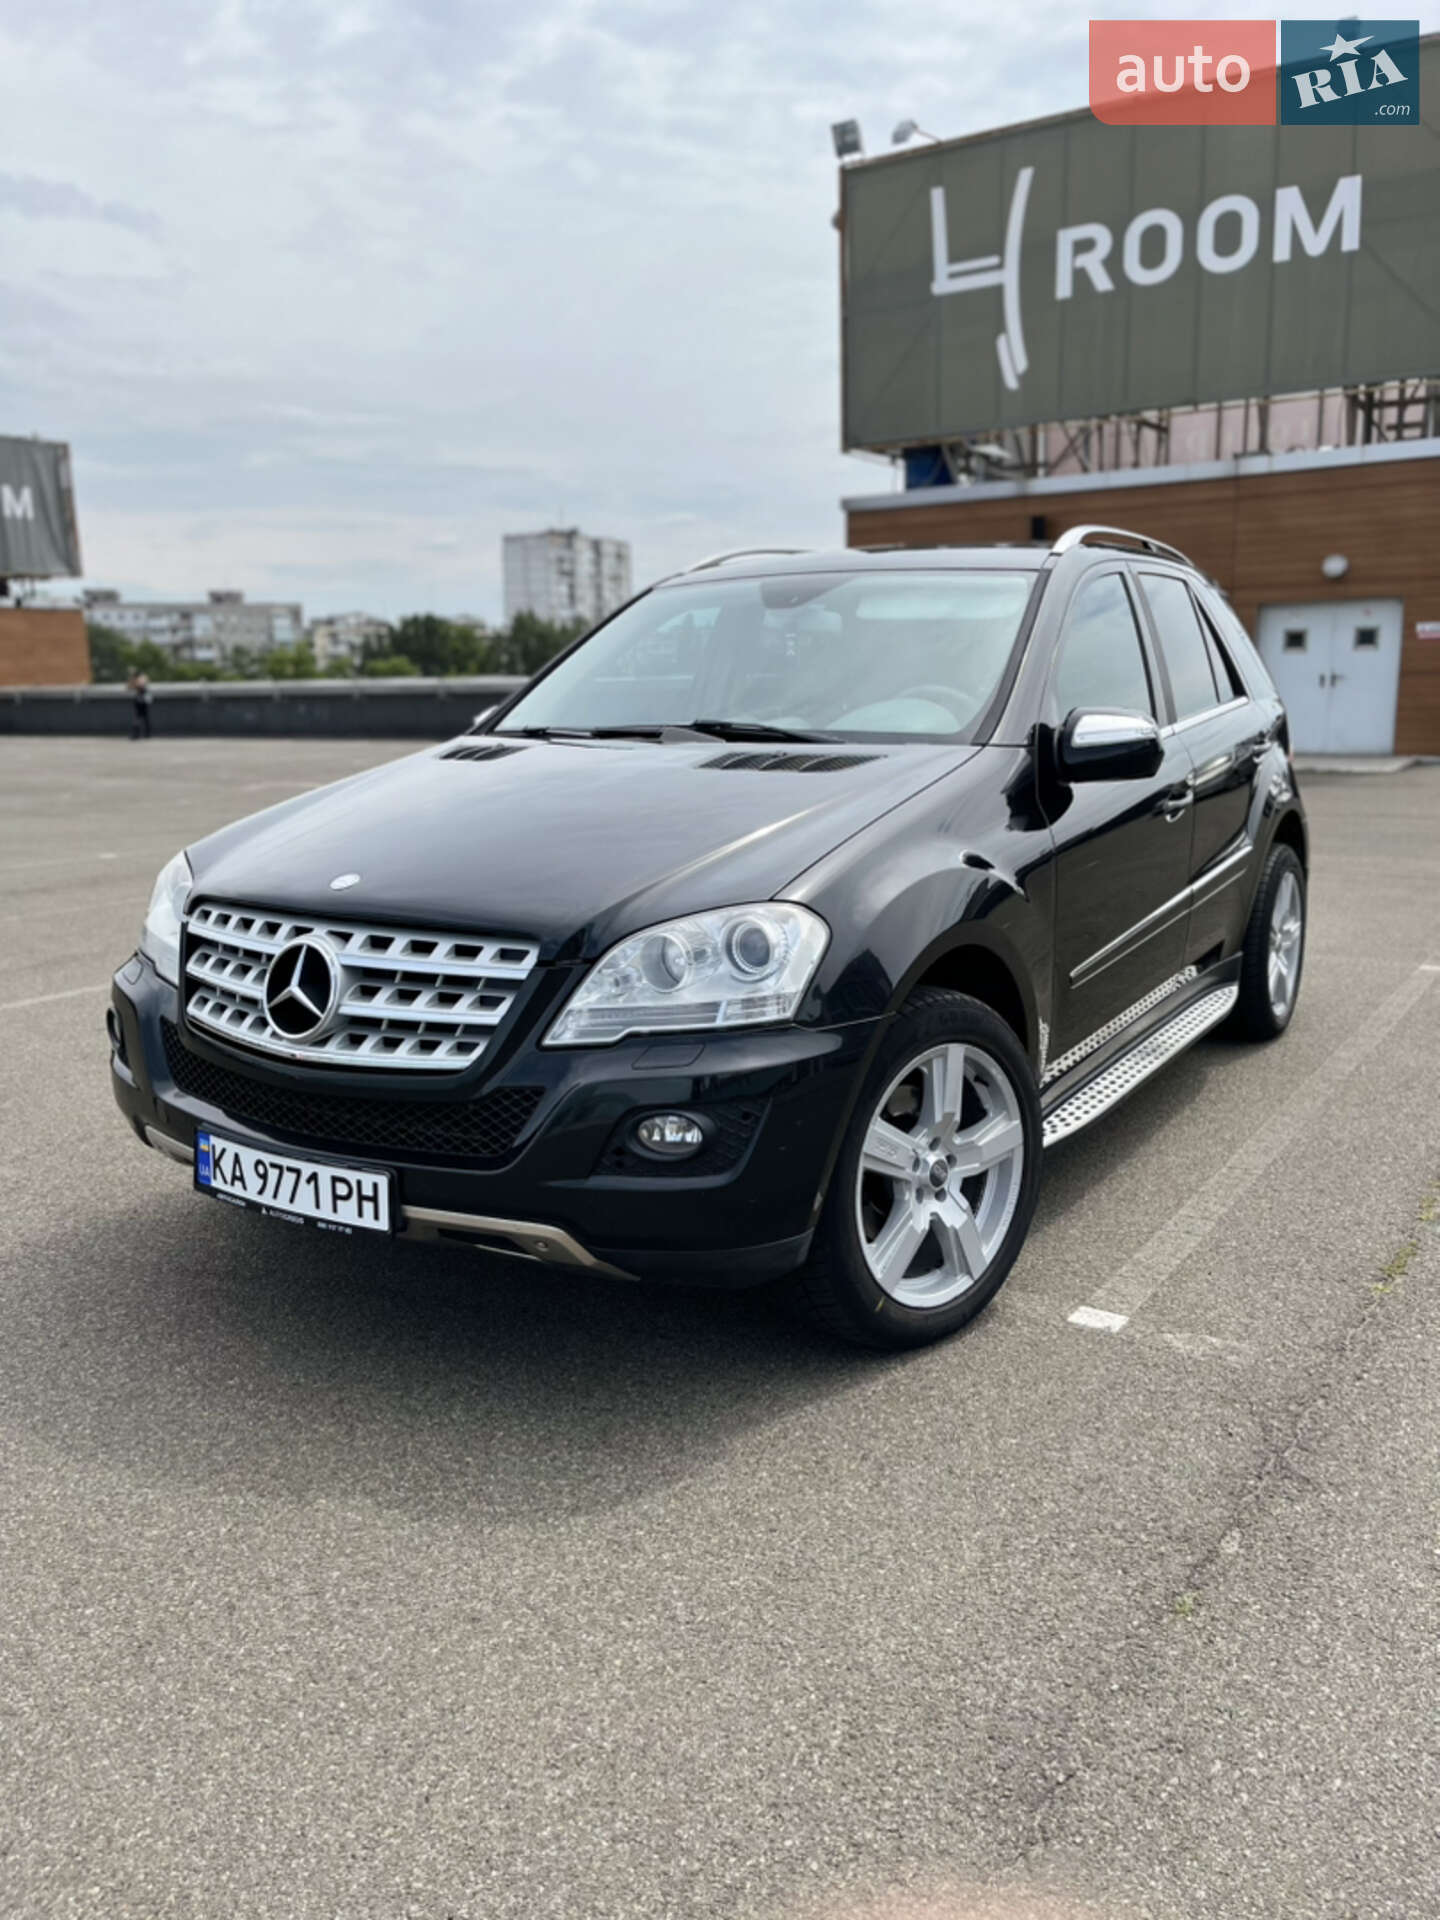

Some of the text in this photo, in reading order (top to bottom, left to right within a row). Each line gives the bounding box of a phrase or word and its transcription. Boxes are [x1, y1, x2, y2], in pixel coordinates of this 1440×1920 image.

[1055, 174, 1362, 300] ROOM
[212, 1143, 380, 1222] KA 9771 PH
